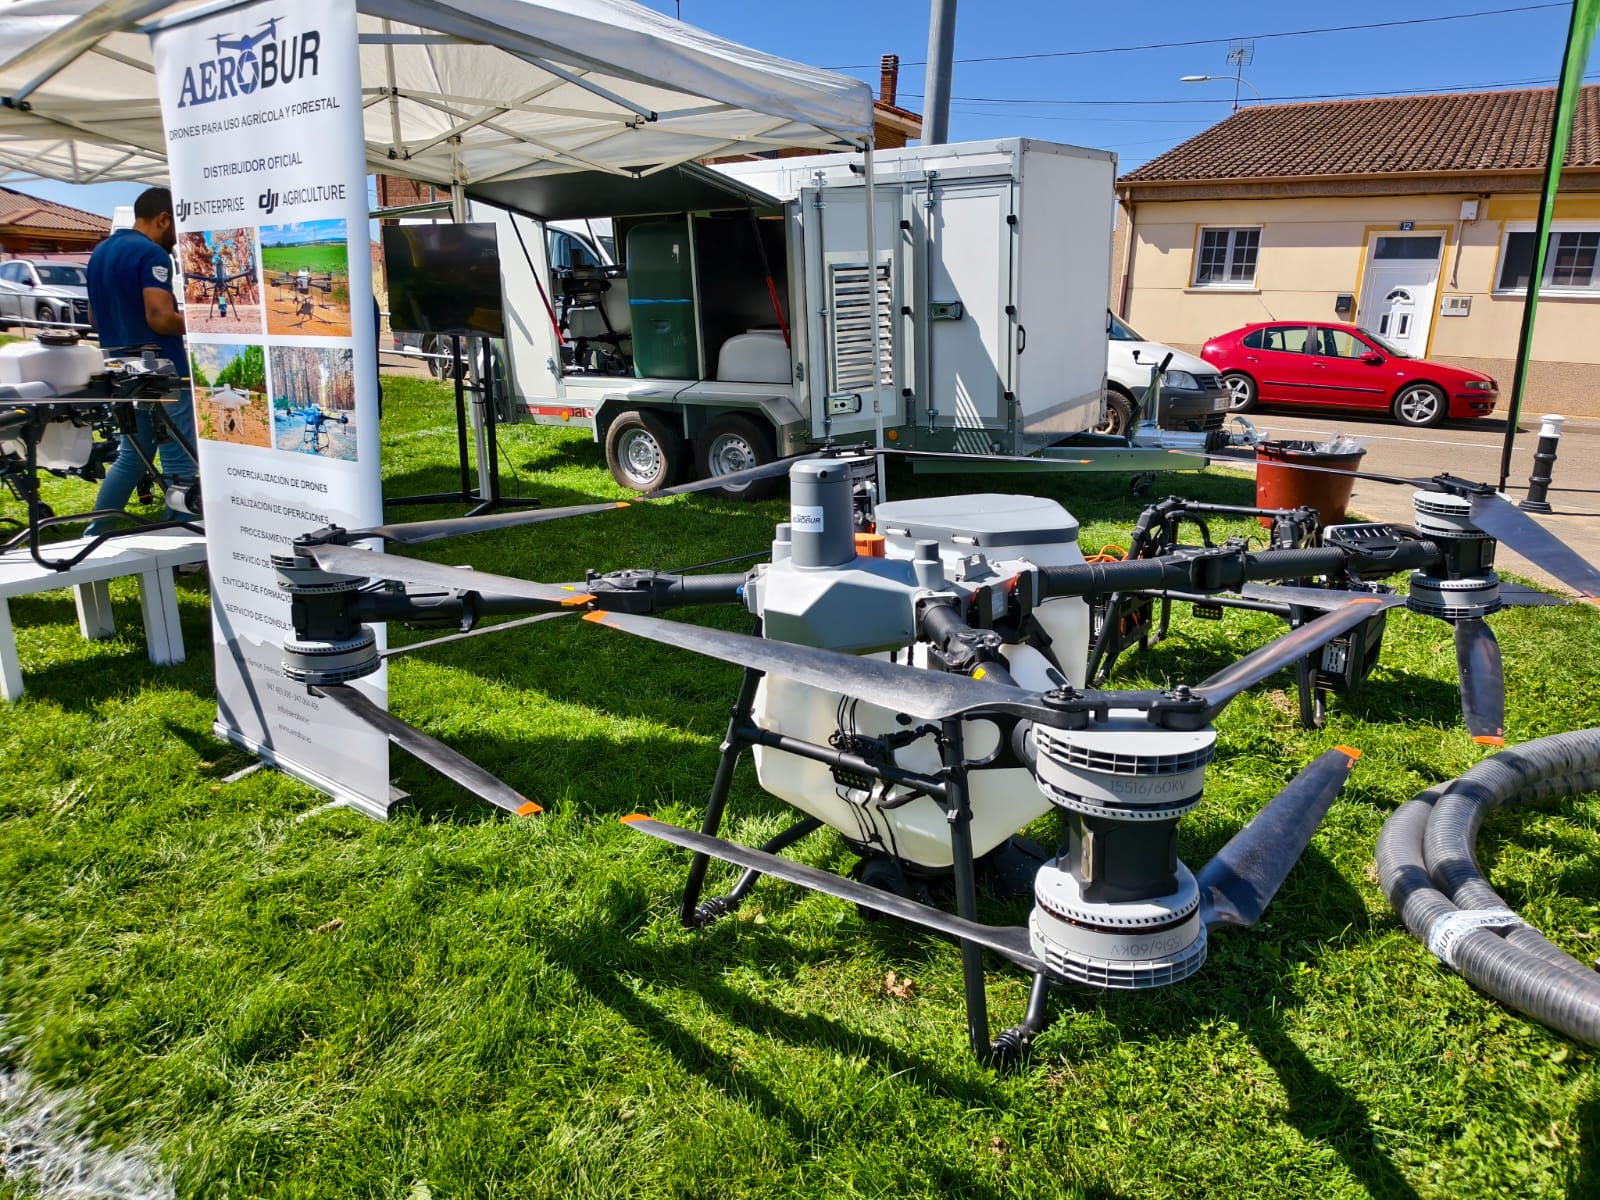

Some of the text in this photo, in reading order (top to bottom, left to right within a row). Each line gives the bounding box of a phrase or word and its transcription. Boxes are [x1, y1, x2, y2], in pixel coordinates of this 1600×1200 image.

[178, 30, 321, 108] AEROBUR
[169, 96, 340, 141] DRONES PARA USO AGRÍCOLA Y FORESTAL
[203, 152, 303, 179] DISTRIBUIDOR OFICIAL
[175, 184, 346, 222] dji ENTERPRISE dji AGRICULTURE
[1402, 222, 1412, 230] 12
[290, 479, 300, 488] DE
[300, 480, 328, 494] DRONES
[273, 505, 282, 515] DE
[282, 507, 329, 525] OPERACIONES
[240, 525, 293, 546] PROCESAMIENTO
[232, 551, 261, 566] SERVICIO
[261, 559, 271, 569] DE
[222, 576, 250, 590] ENTIDAD
[250, 583, 260, 594] DE
[225, 603, 294, 632] SERVICIO DE CONSULT
[1110, 779, 1187, 795] 15516/60KV
[1110, 935, 1184, 957] 15516/60KV
